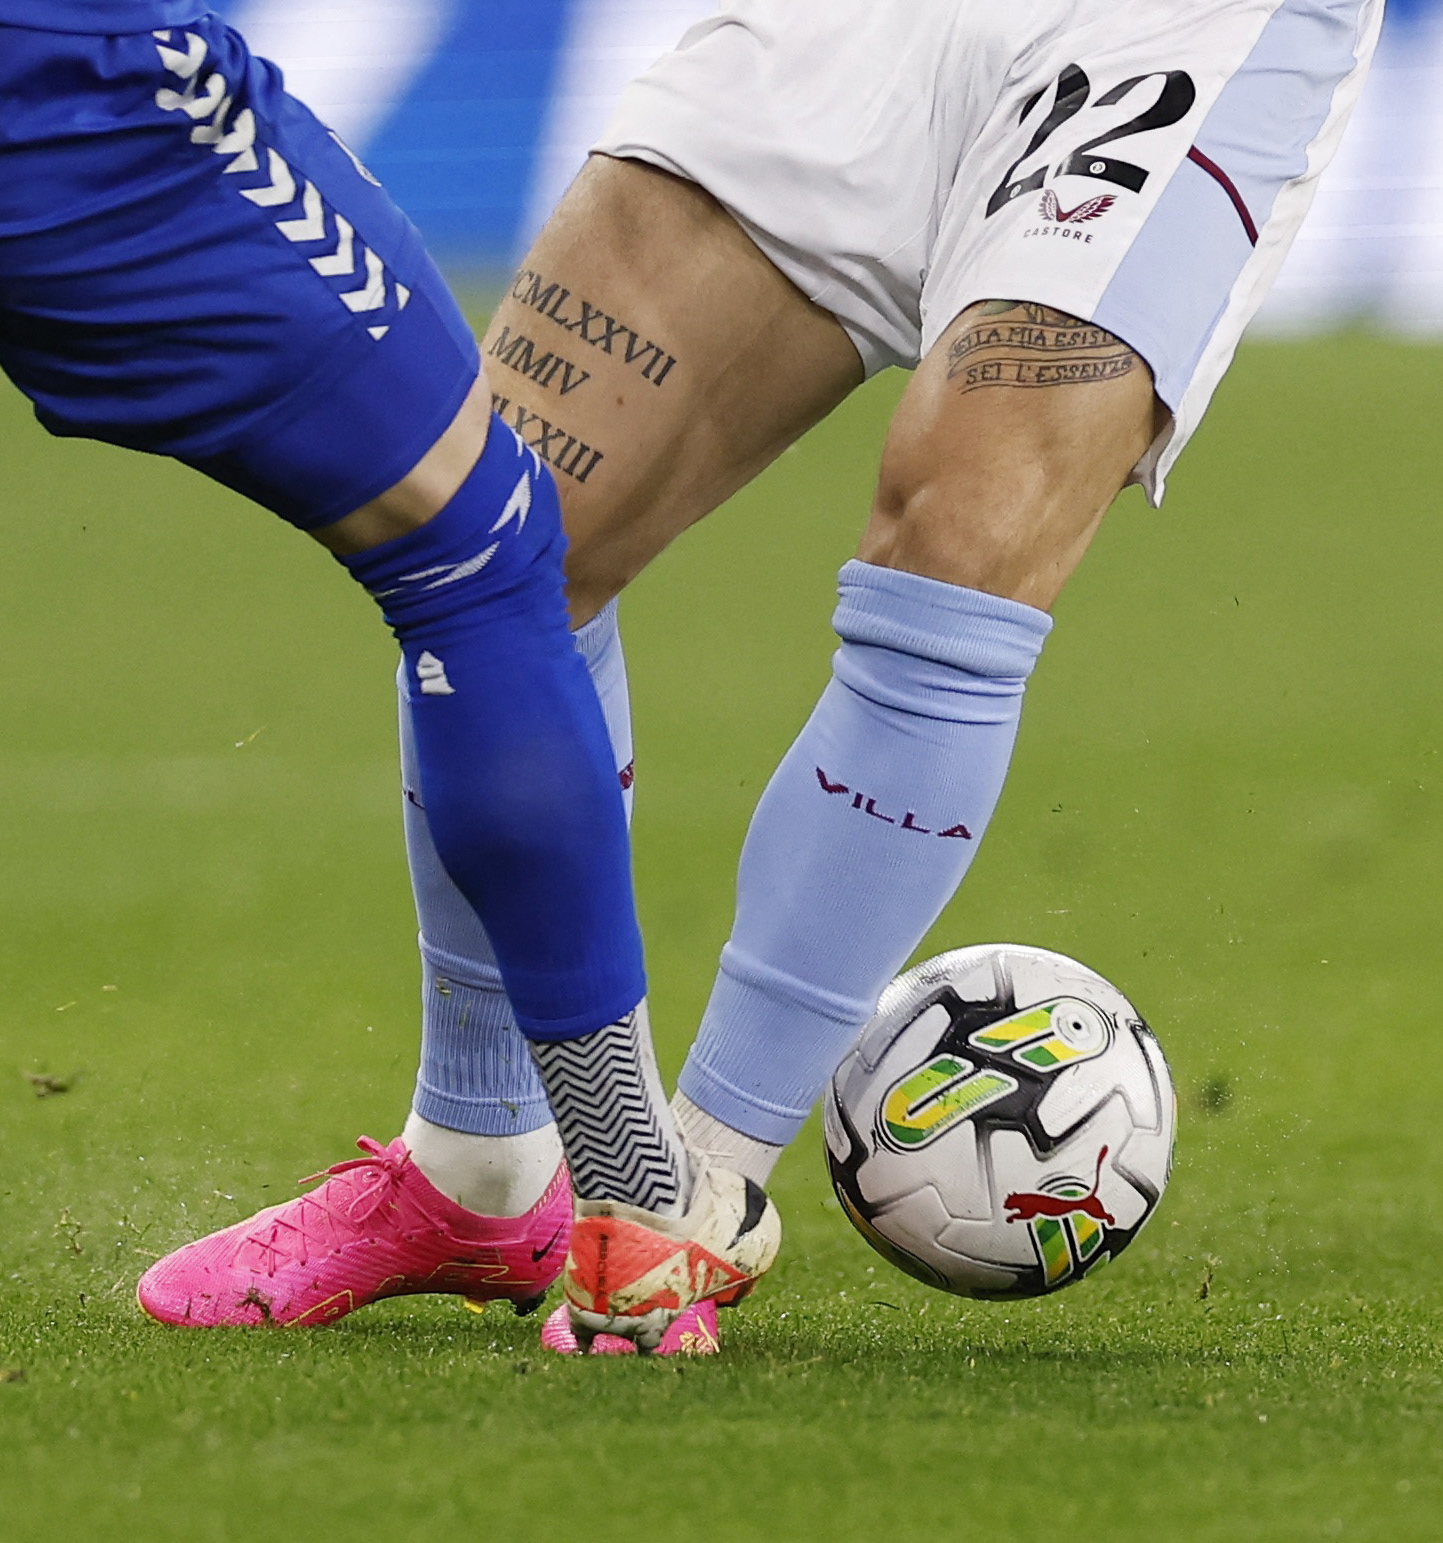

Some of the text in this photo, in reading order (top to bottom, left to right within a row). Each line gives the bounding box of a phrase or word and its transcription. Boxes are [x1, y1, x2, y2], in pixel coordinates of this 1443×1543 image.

[984, 62, 1197, 220] 22
[1022, 226, 1094, 245] CASTORE
[488, 325, 591, 396] MMIV
[965, 362, 1002, 385] SEI
[491, 392, 605, 484] XXIII
[815, 766, 973, 840] VILLA
